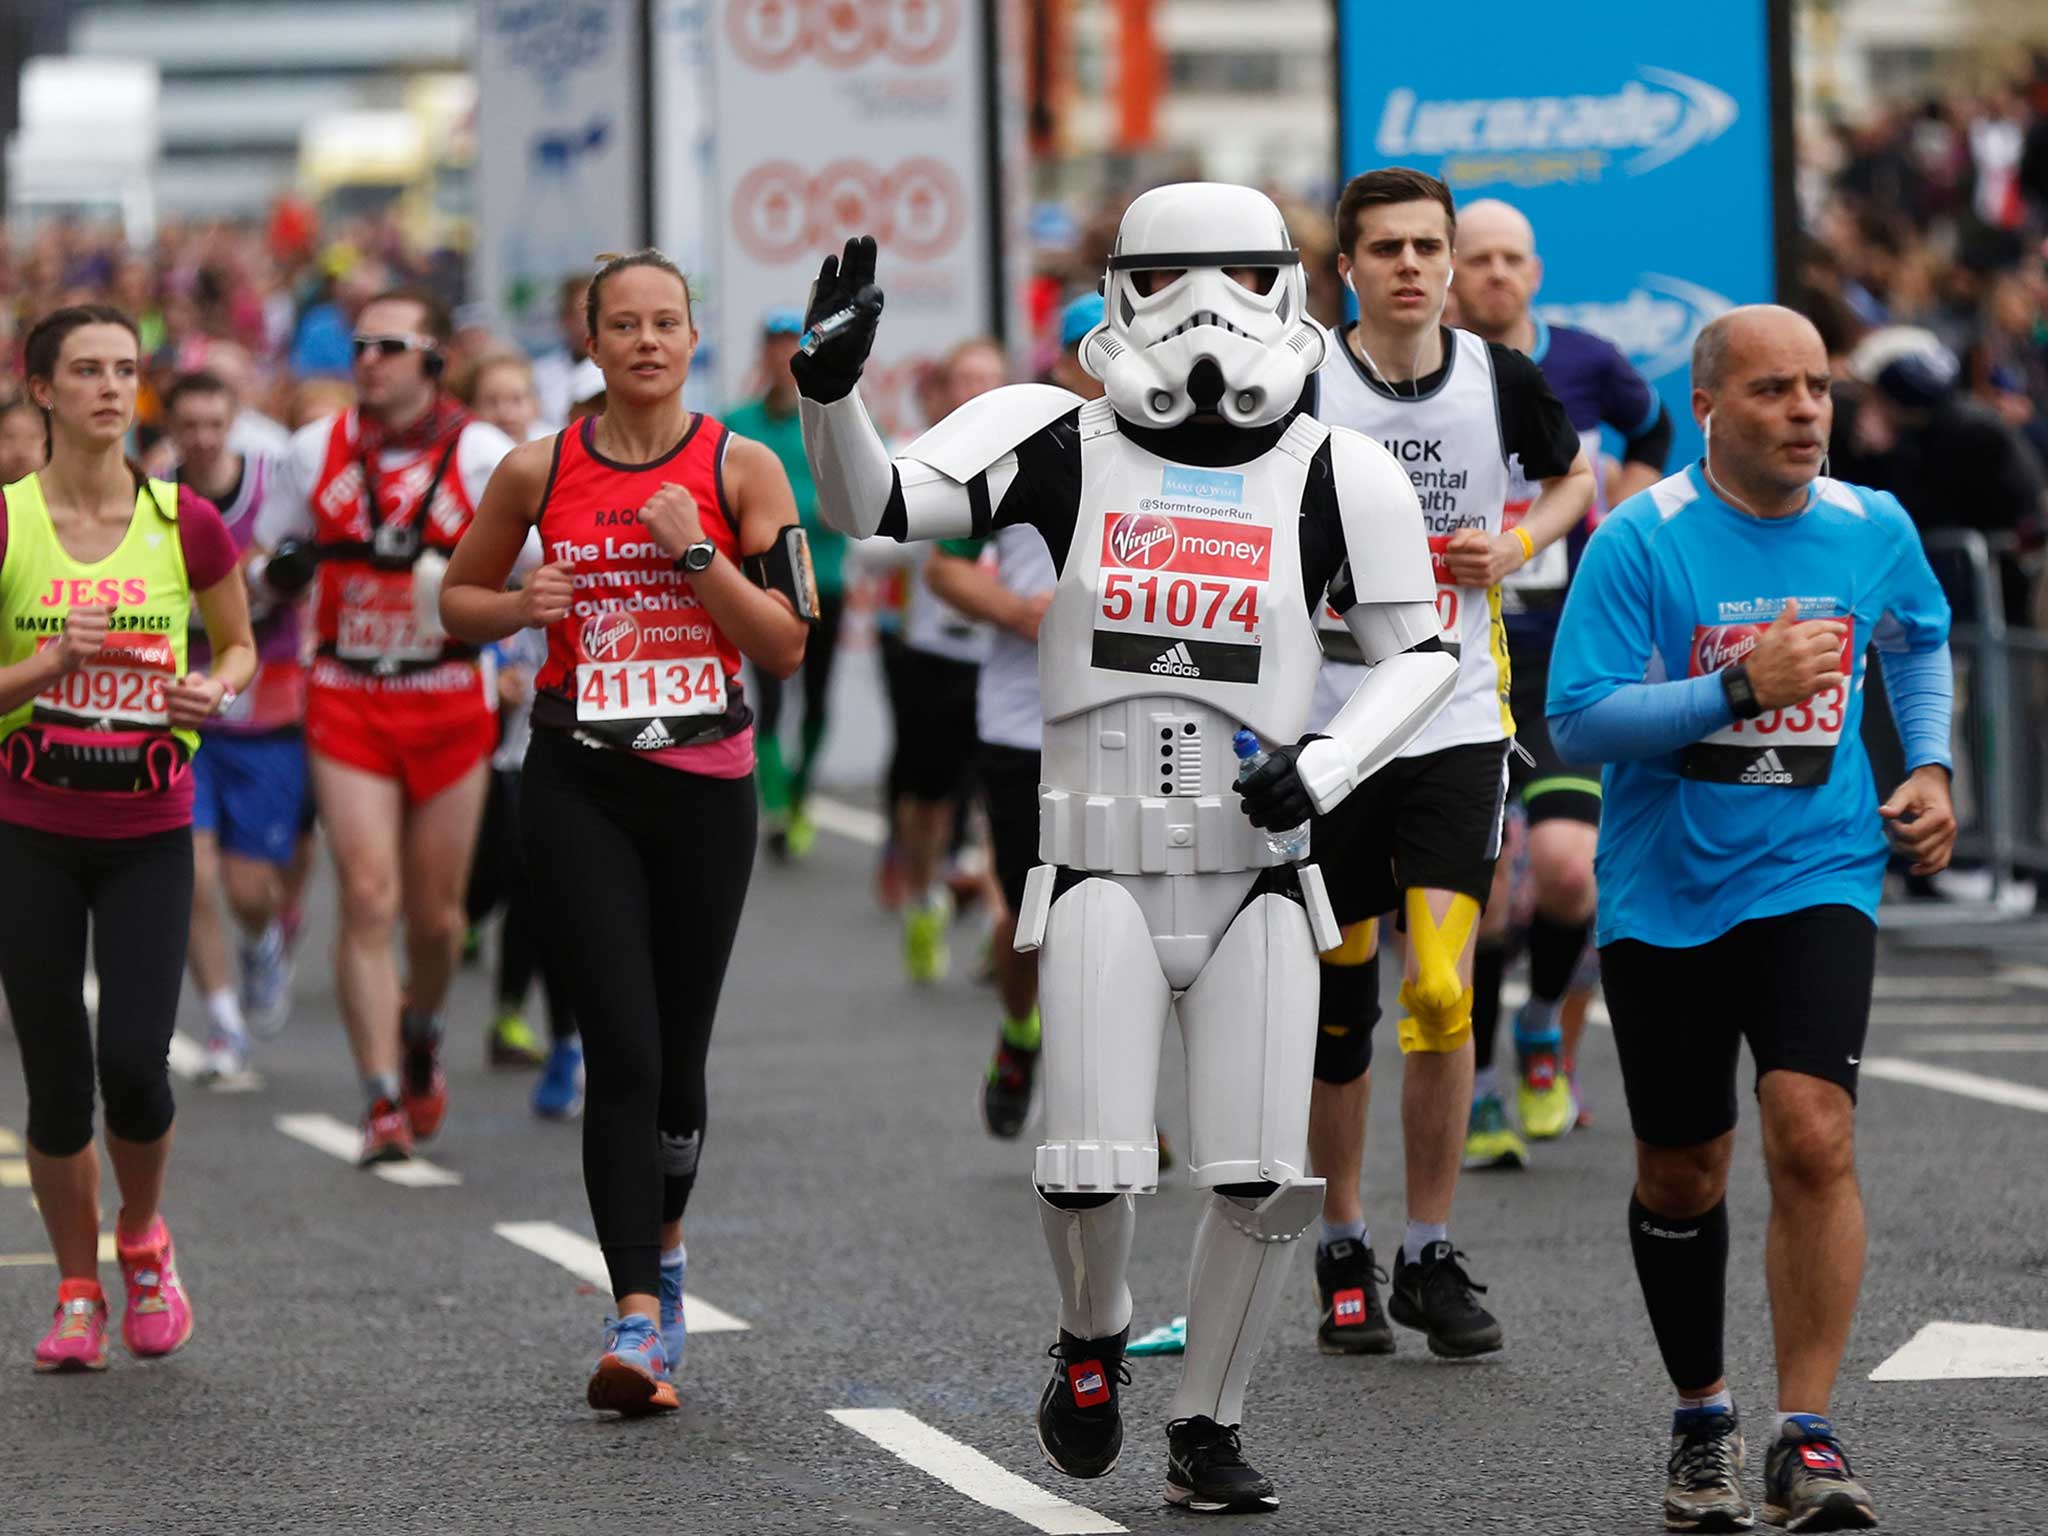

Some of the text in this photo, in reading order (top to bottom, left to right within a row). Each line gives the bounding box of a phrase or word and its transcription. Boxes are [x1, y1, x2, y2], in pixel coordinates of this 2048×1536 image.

[1376, 82, 1688, 156] Lucozade
[1385, 439, 1442, 462] ICK
[1409, 469, 1468, 490] ental
[1139, 498, 1253, 520] @StormtrooperRun
[1417, 491, 1456, 512] alth
[1423, 513, 1487, 533] ndation
[1114, 514, 1264, 565] Virgin money
[552, 540, 598, 562] The
[573, 568, 685, 589] ommuni
[40, 578, 147, 607] JESS
[1102, 574, 1259, 633] 51074
[562, 589, 700, 619] oundatio
[1718, 600, 1752, 614] ING
[15, 615, 171, 632] HAVE OSPICES
[584, 613, 712, 659] Virgin money
[1254, 634, 1261, 644] 5
[1701, 625, 1758, 671] Virgin
[1150, 661, 1200, 677] adidas
[43, 671, 168, 713] 40928
[582, 664, 720, 710] 41134
[632, 736, 675, 750] adidas
[1740, 772, 1793, 784] adidas
